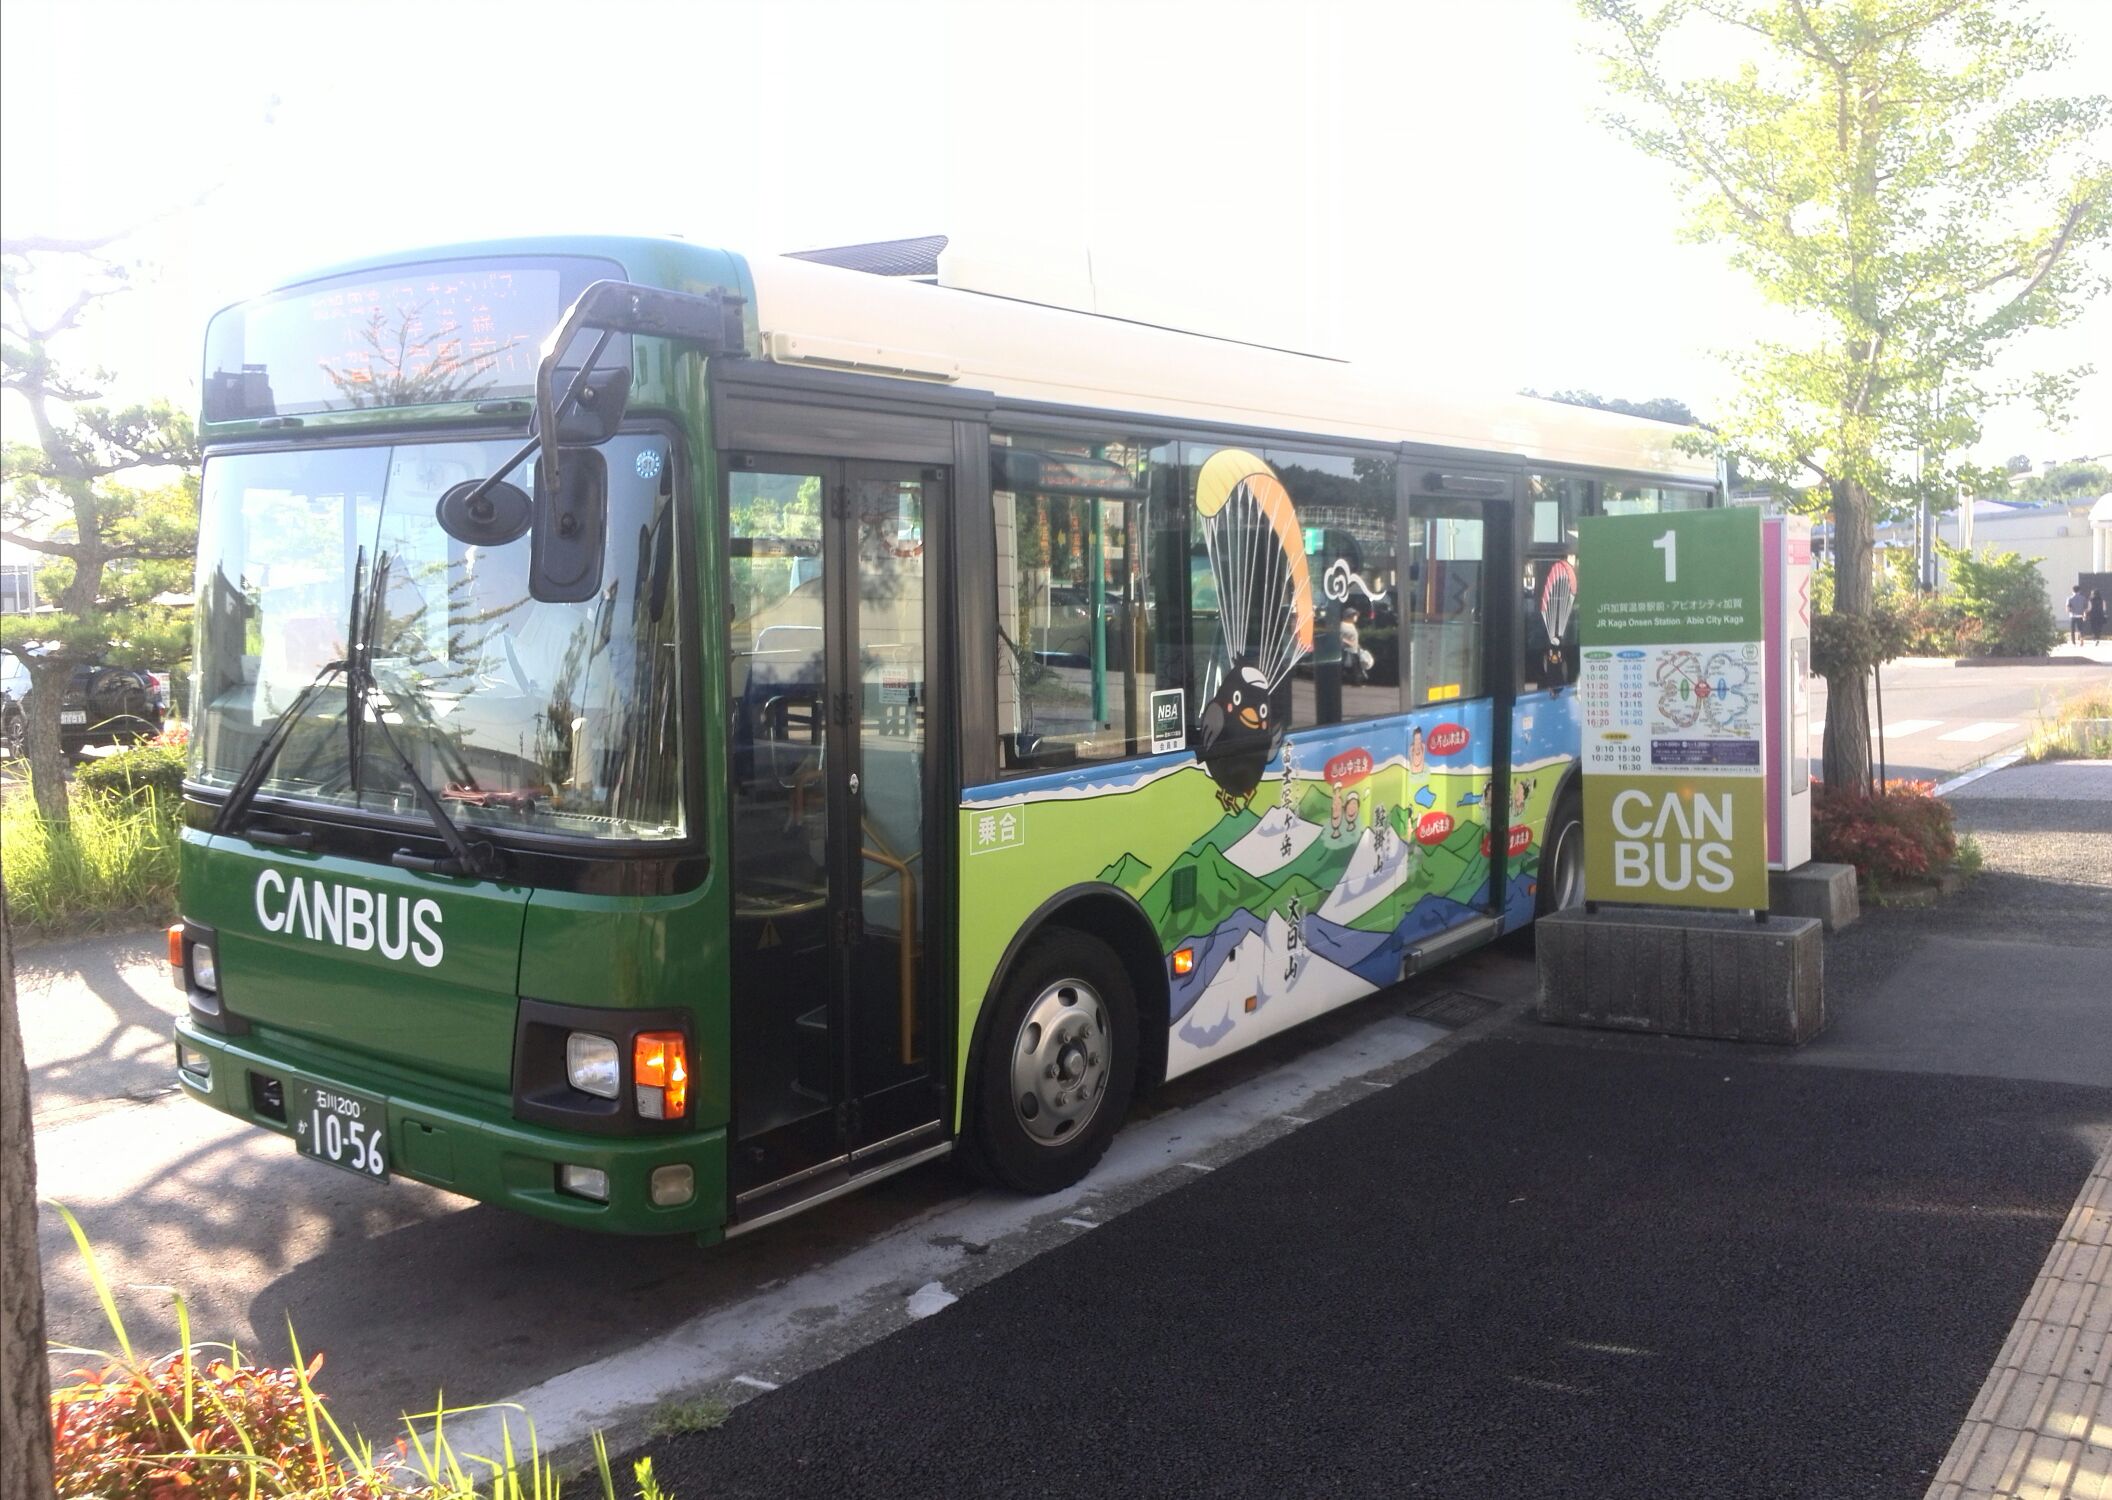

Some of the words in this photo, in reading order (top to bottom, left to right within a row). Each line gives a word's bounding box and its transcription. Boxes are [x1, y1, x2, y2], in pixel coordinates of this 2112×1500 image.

[1653, 530, 1676, 582] 1
[1597, 619, 1606, 628] JR
[1608, 618, 1627, 629] Kaga
[1628, 618, 1653, 627] Onsen
[1654, 617, 1681, 626] Station
[1686, 616, 1705, 625] Abio
[1706, 615, 1722, 625] City
[1723, 615, 1744, 626] Kaga
[1157, 703, 1178, 719] NBA
[979, 812, 1017, 846] 乗合
[1612, 789, 1733, 841] CAN
[1614, 840, 1735, 894] BUS
[256, 868, 444, 968] CANBUS
[1284, 896, 1299, 982] 大日山
[313, 1108, 384, 1175] 10-56
